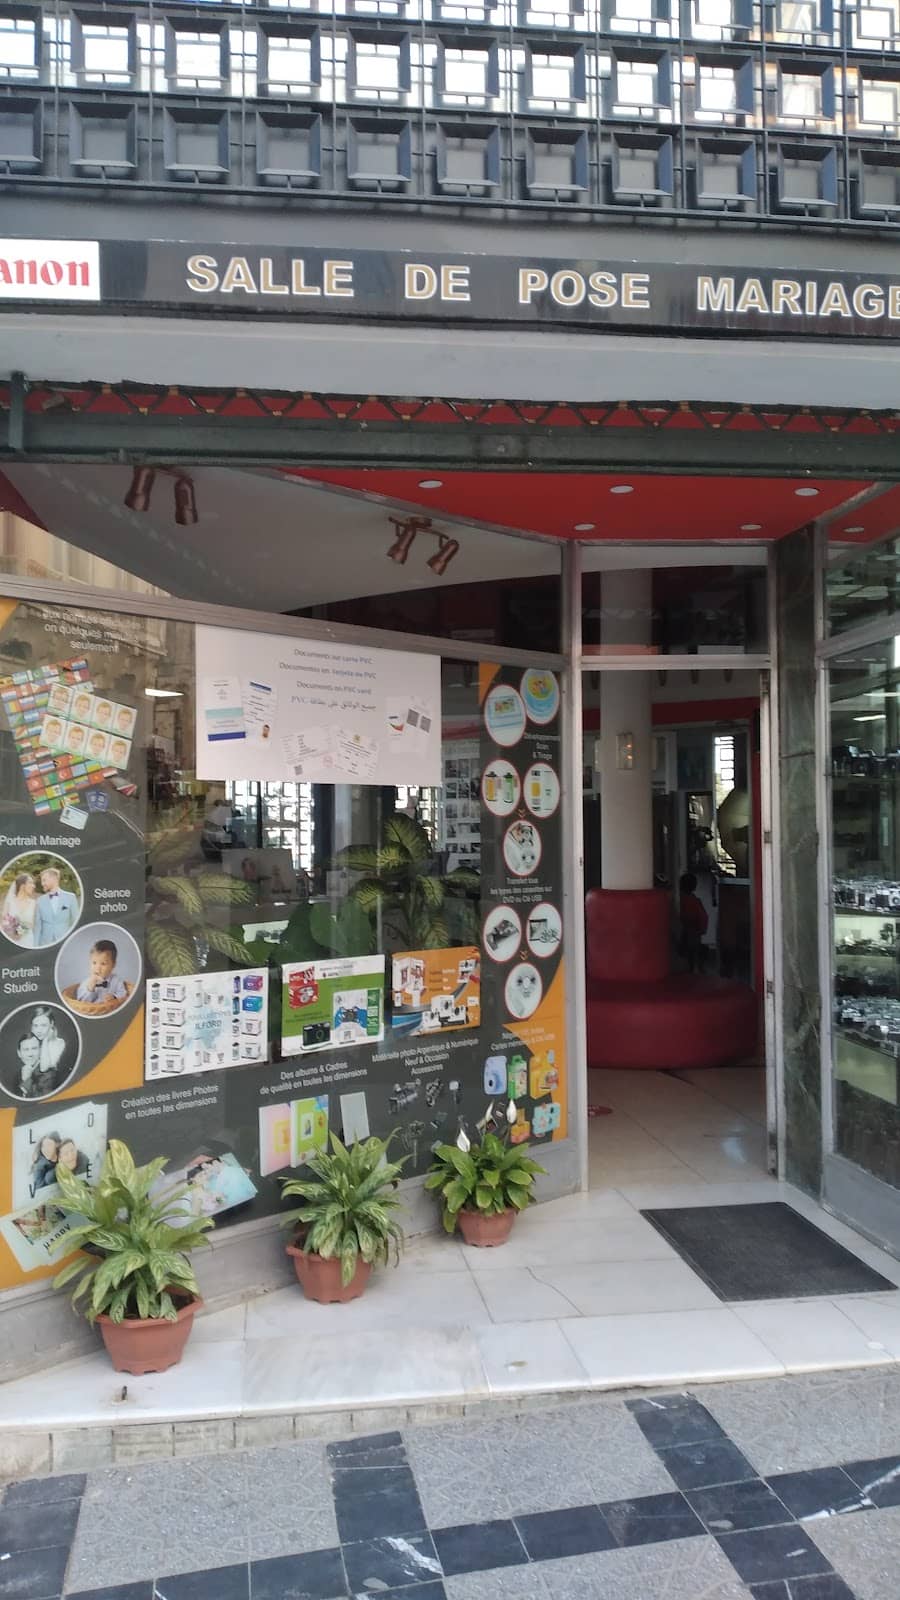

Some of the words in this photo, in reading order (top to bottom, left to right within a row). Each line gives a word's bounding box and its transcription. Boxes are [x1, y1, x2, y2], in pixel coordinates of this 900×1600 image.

[186, 254, 354, 297] SALLE
[404, 263, 471, 302] DE
[518, 268, 650, 309] POSE
[696, 275, 900, 319] MARIAGE
[59, 625, 102, 640] quelques
[70, 640, 118, 653] seulement
[364, 671, 377, 679] PVC
[0, 834, 37, 846] Portrait
[40, 835, 81, 848] Mariage
[94, 887, 131, 899] Séance
[100, 902, 128, 915] photo
[1, 966, 40, 979] Portrait
[3, 981, 38, 994] Studio
[280, 1071, 294, 1080] Des
[295, 1066, 318, 1077] albums
[318, 1065, 325, 1073] &
[325, 1061, 348, 1072] Cadres
[260, 1086, 269, 1095] de
[270, 1081, 292, 1094] qualité
[293, 1081, 302, 1089] en
[303, 1076, 322, 1087] toutes
[323, 1074, 333, 1083] les
[334, 1068, 367, 1081] dimensions
[121, 1095, 155, 1109] Création
[156, 1094, 171, 1103] des
[172, 1089, 192, 1100] livres
[193, 1085, 219, 1096] Photos
[125, 1111, 136, 1120] en
[138, 1106, 161, 1118] toutes
[163, 1104, 175, 1113] les
[176, 1096, 217, 1111] dimensions
[29, 1128, 36, 1144] L
[29, 1183, 36, 1198] V
